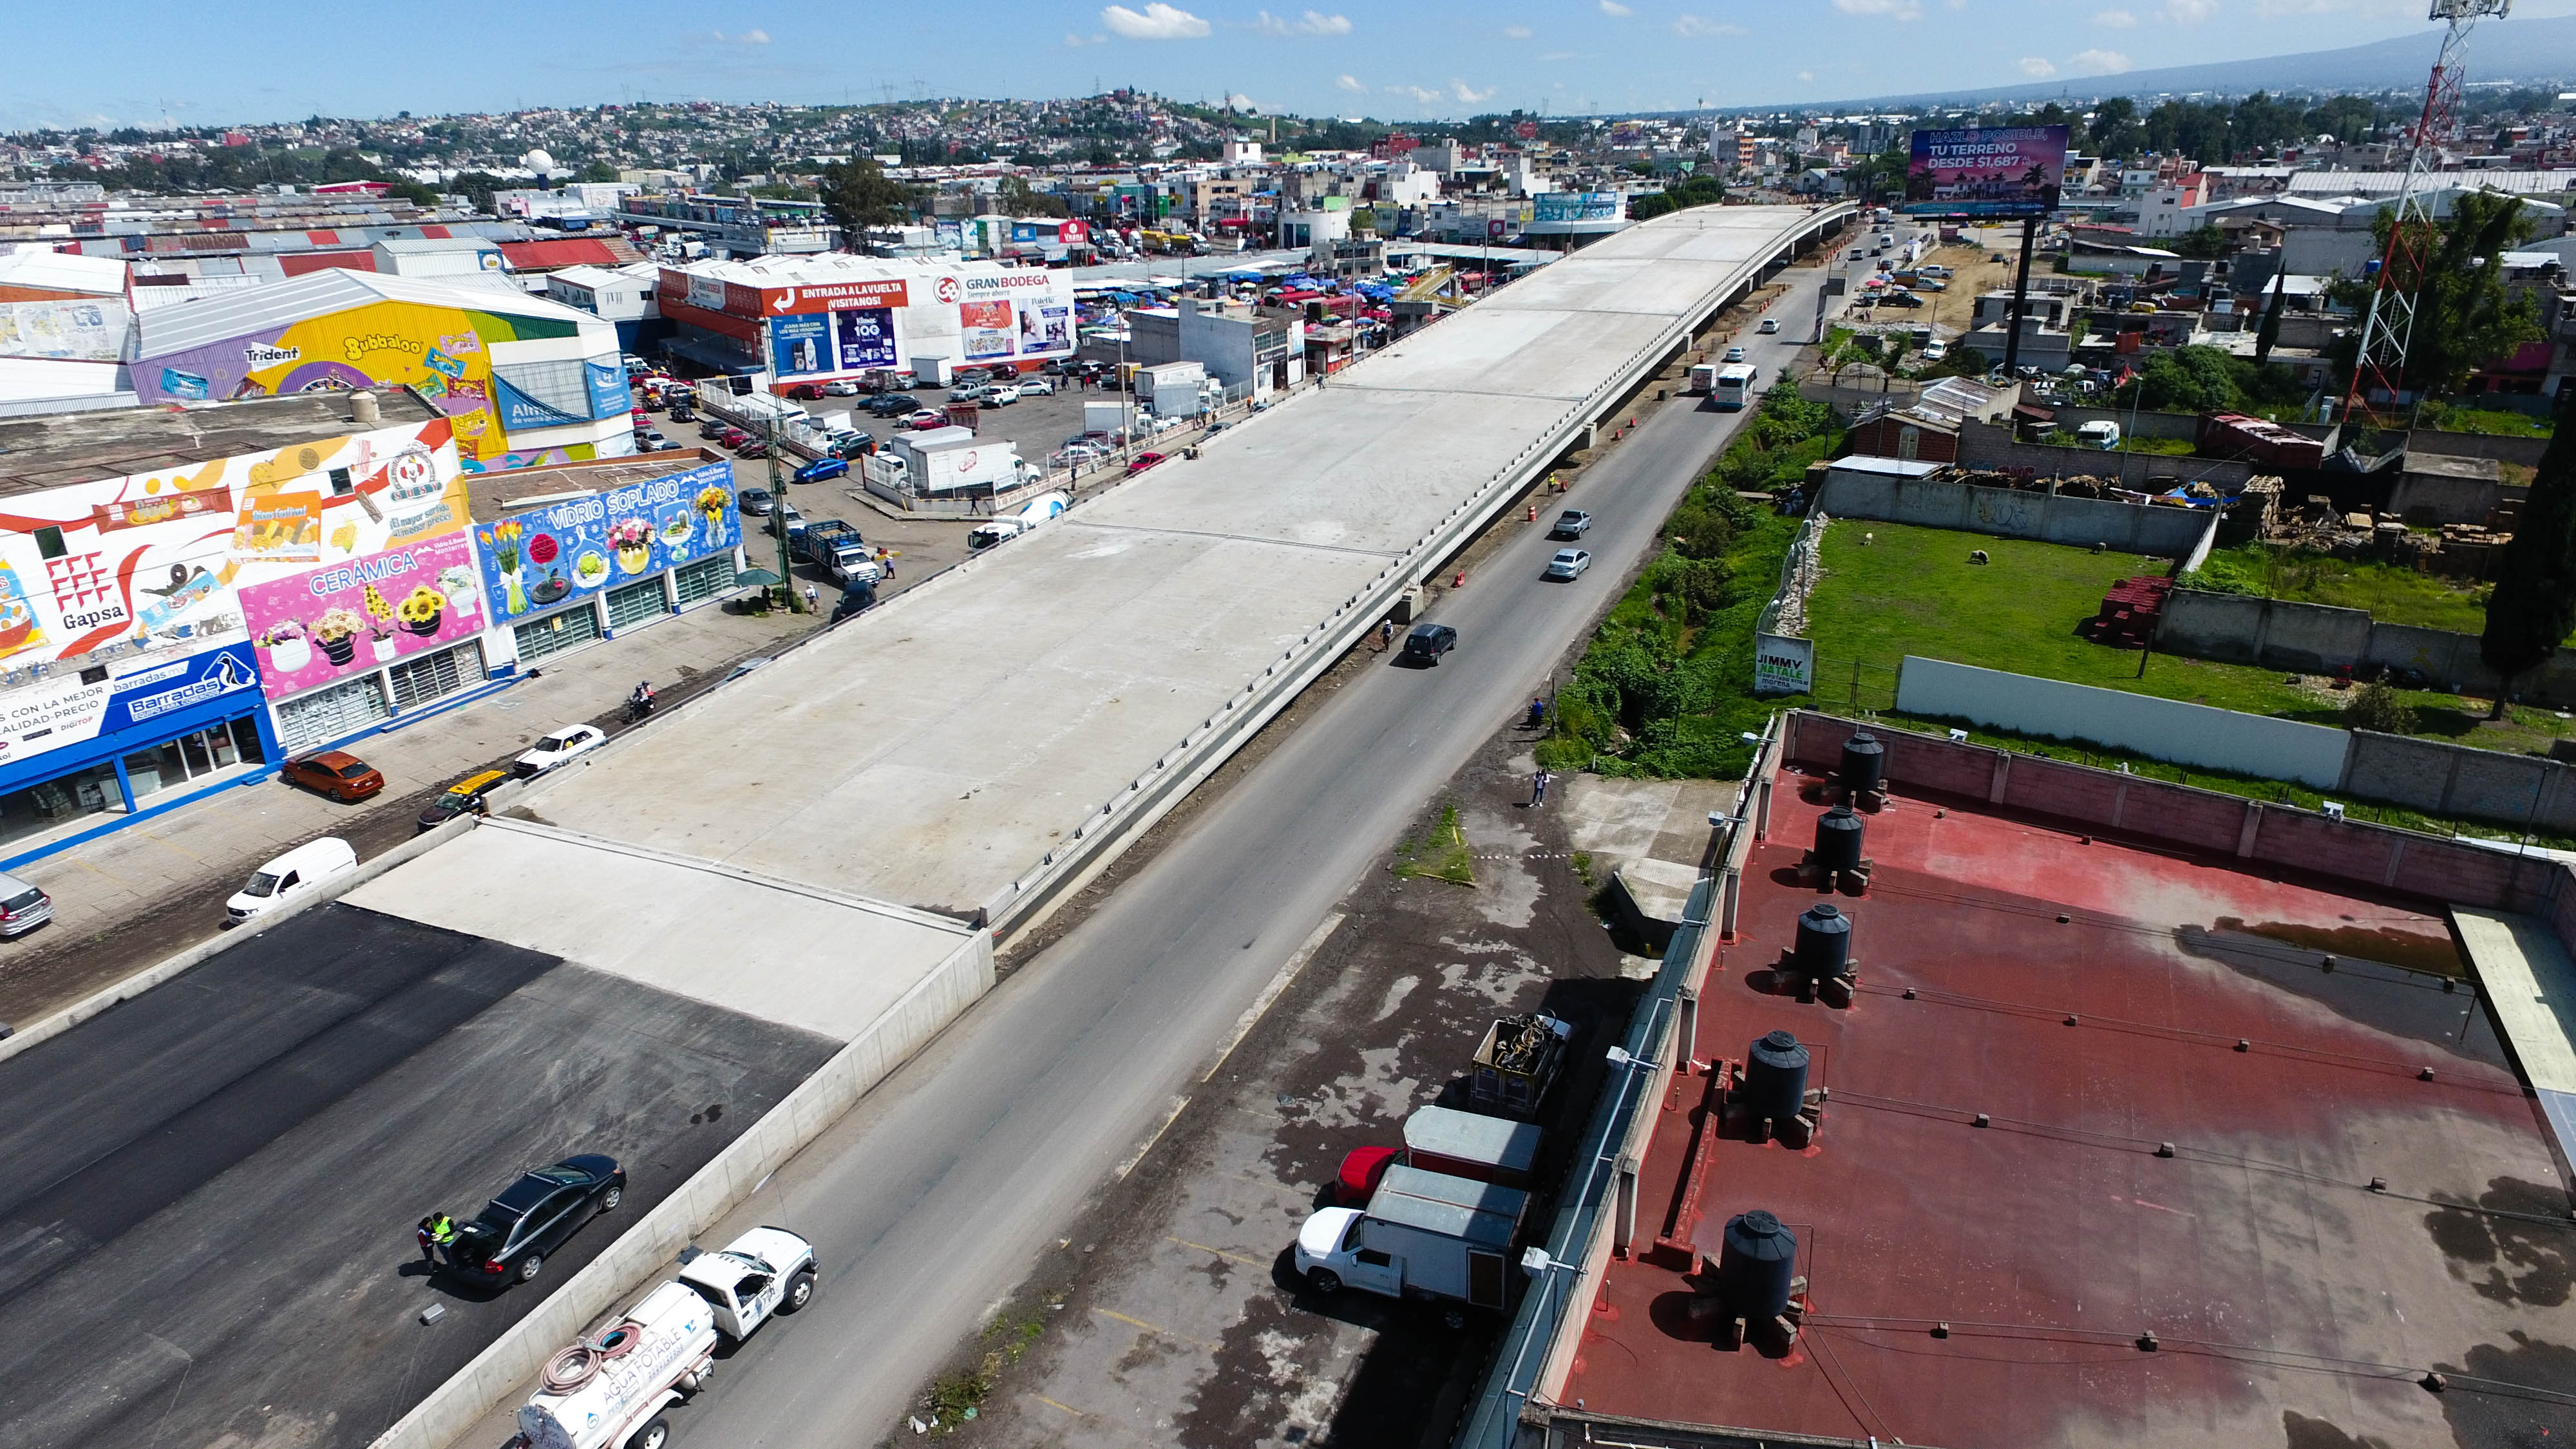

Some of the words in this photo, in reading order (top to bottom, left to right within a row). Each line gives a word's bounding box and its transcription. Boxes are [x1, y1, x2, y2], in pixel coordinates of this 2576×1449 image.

[1930, 131, 1979, 144] HAZLO
[1982, 128, 2048, 142] POSIBLE,
[1929, 144, 1947, 156] TU
[1950, 143, 2017, 155] TERRENO
[1927, 157, 1974, 169] DESDE
[1000, 275, 1050, 288] BODEGA
[802, 286, 849, 298] ENTRADA
[848, 286, 855, 295] A
[855, 285, 868, 294] LA
[867, 283, 902, 294] VUELTA
[245, 346, 299, 362] Trident
[343, 334, 421, 361] Bubbaloo
[697, 472, 726, 484] Monterrey
[547, 500, 605, 531] VIDRIO
[607, 478, 680, 515] SOPLADO
[401, 513, 424, 527] mayor
[424, 504, 450, 516] surtido
[401, 524, 425, 536] menor
[435, 542, 469, 556] Monterrey
[310, 551, 418, 596] CERÁMICA
[63, 605, 124, 630] Gapsa
[1757, 654, 1803, 670] JIMMY
[113, 665, 186, 693] barradas.mx
[1761, 663, 1804, 679] NATALE
[11, 704, 39, 719] CON
[43, 699, 60, 710] LA
[62, 686, 104, 705] MEJOR
[130, 679, 218, 714] Barradas
[133, 706, 161, 721] EQUIPO
[161, 701, 180, 712] PARA
[61, 716, 93, 731] DIGITOP
[603, 1370, 637, 1405] AGUA
